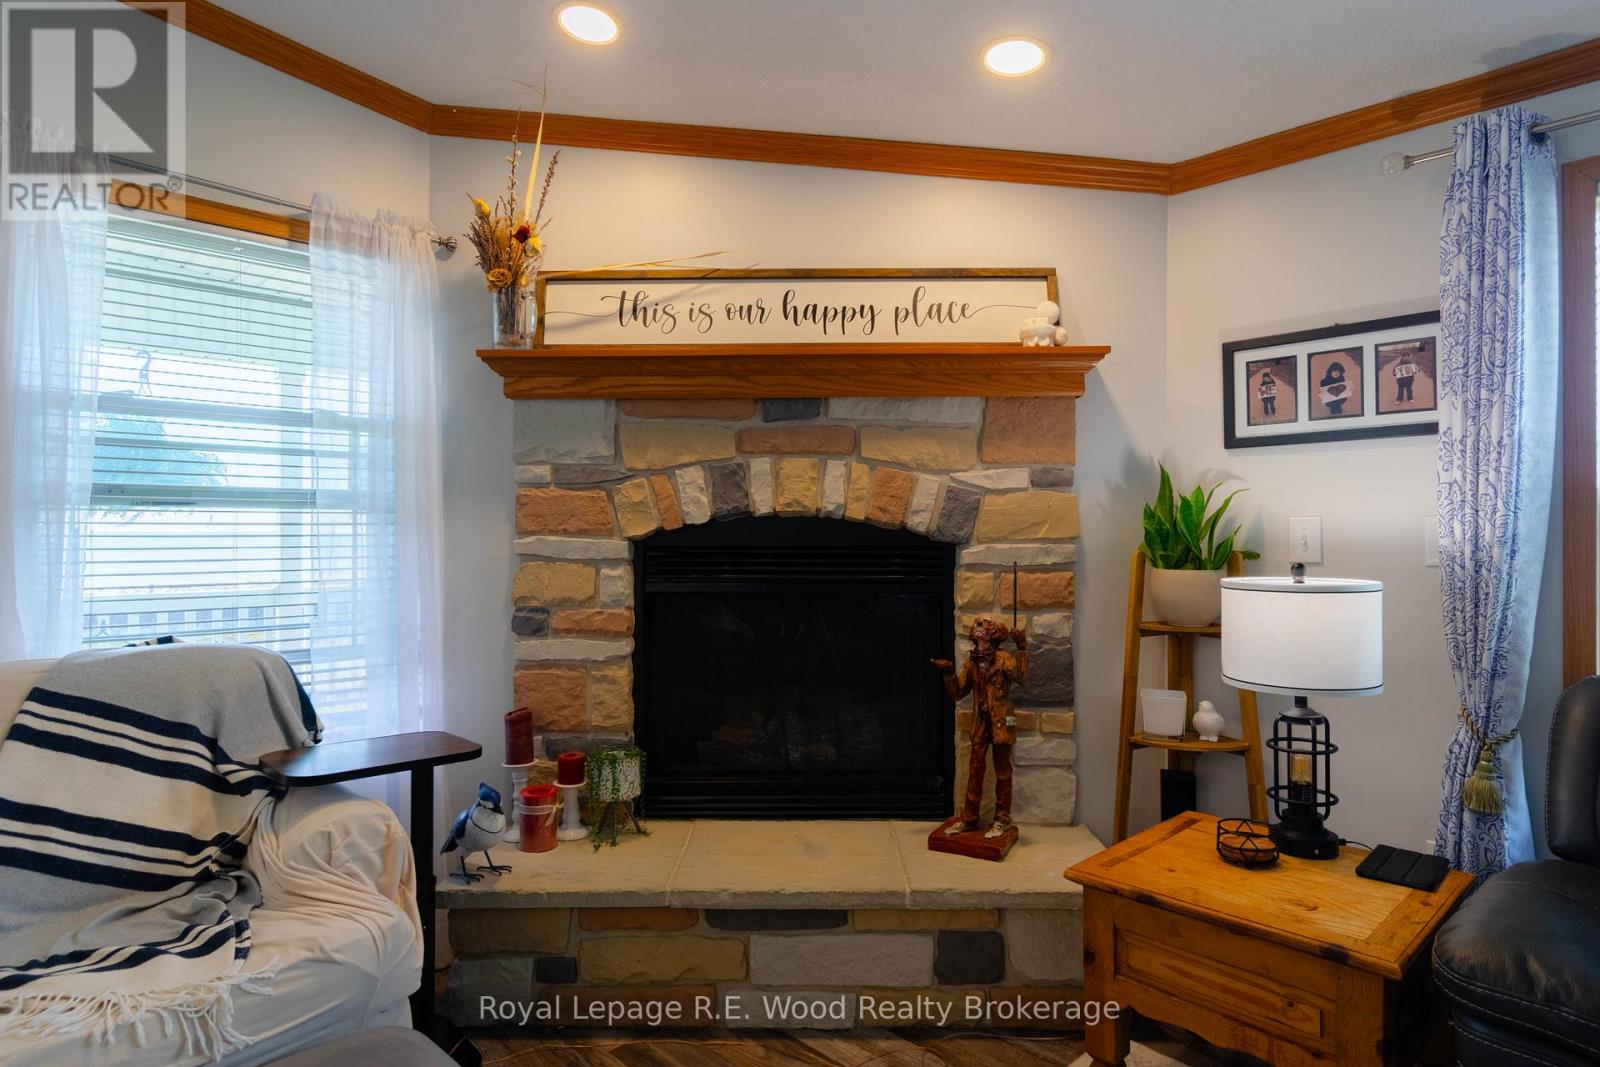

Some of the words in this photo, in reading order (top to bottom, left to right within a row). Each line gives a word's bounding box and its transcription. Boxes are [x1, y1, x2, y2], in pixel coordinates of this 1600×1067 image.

[601, 290, 680, 334] this
[689, 301, 716, 334] is
[725, 298, 772, 325] our
[782, 289, 883, 336] happy
[894, 285, 980, 336] place
